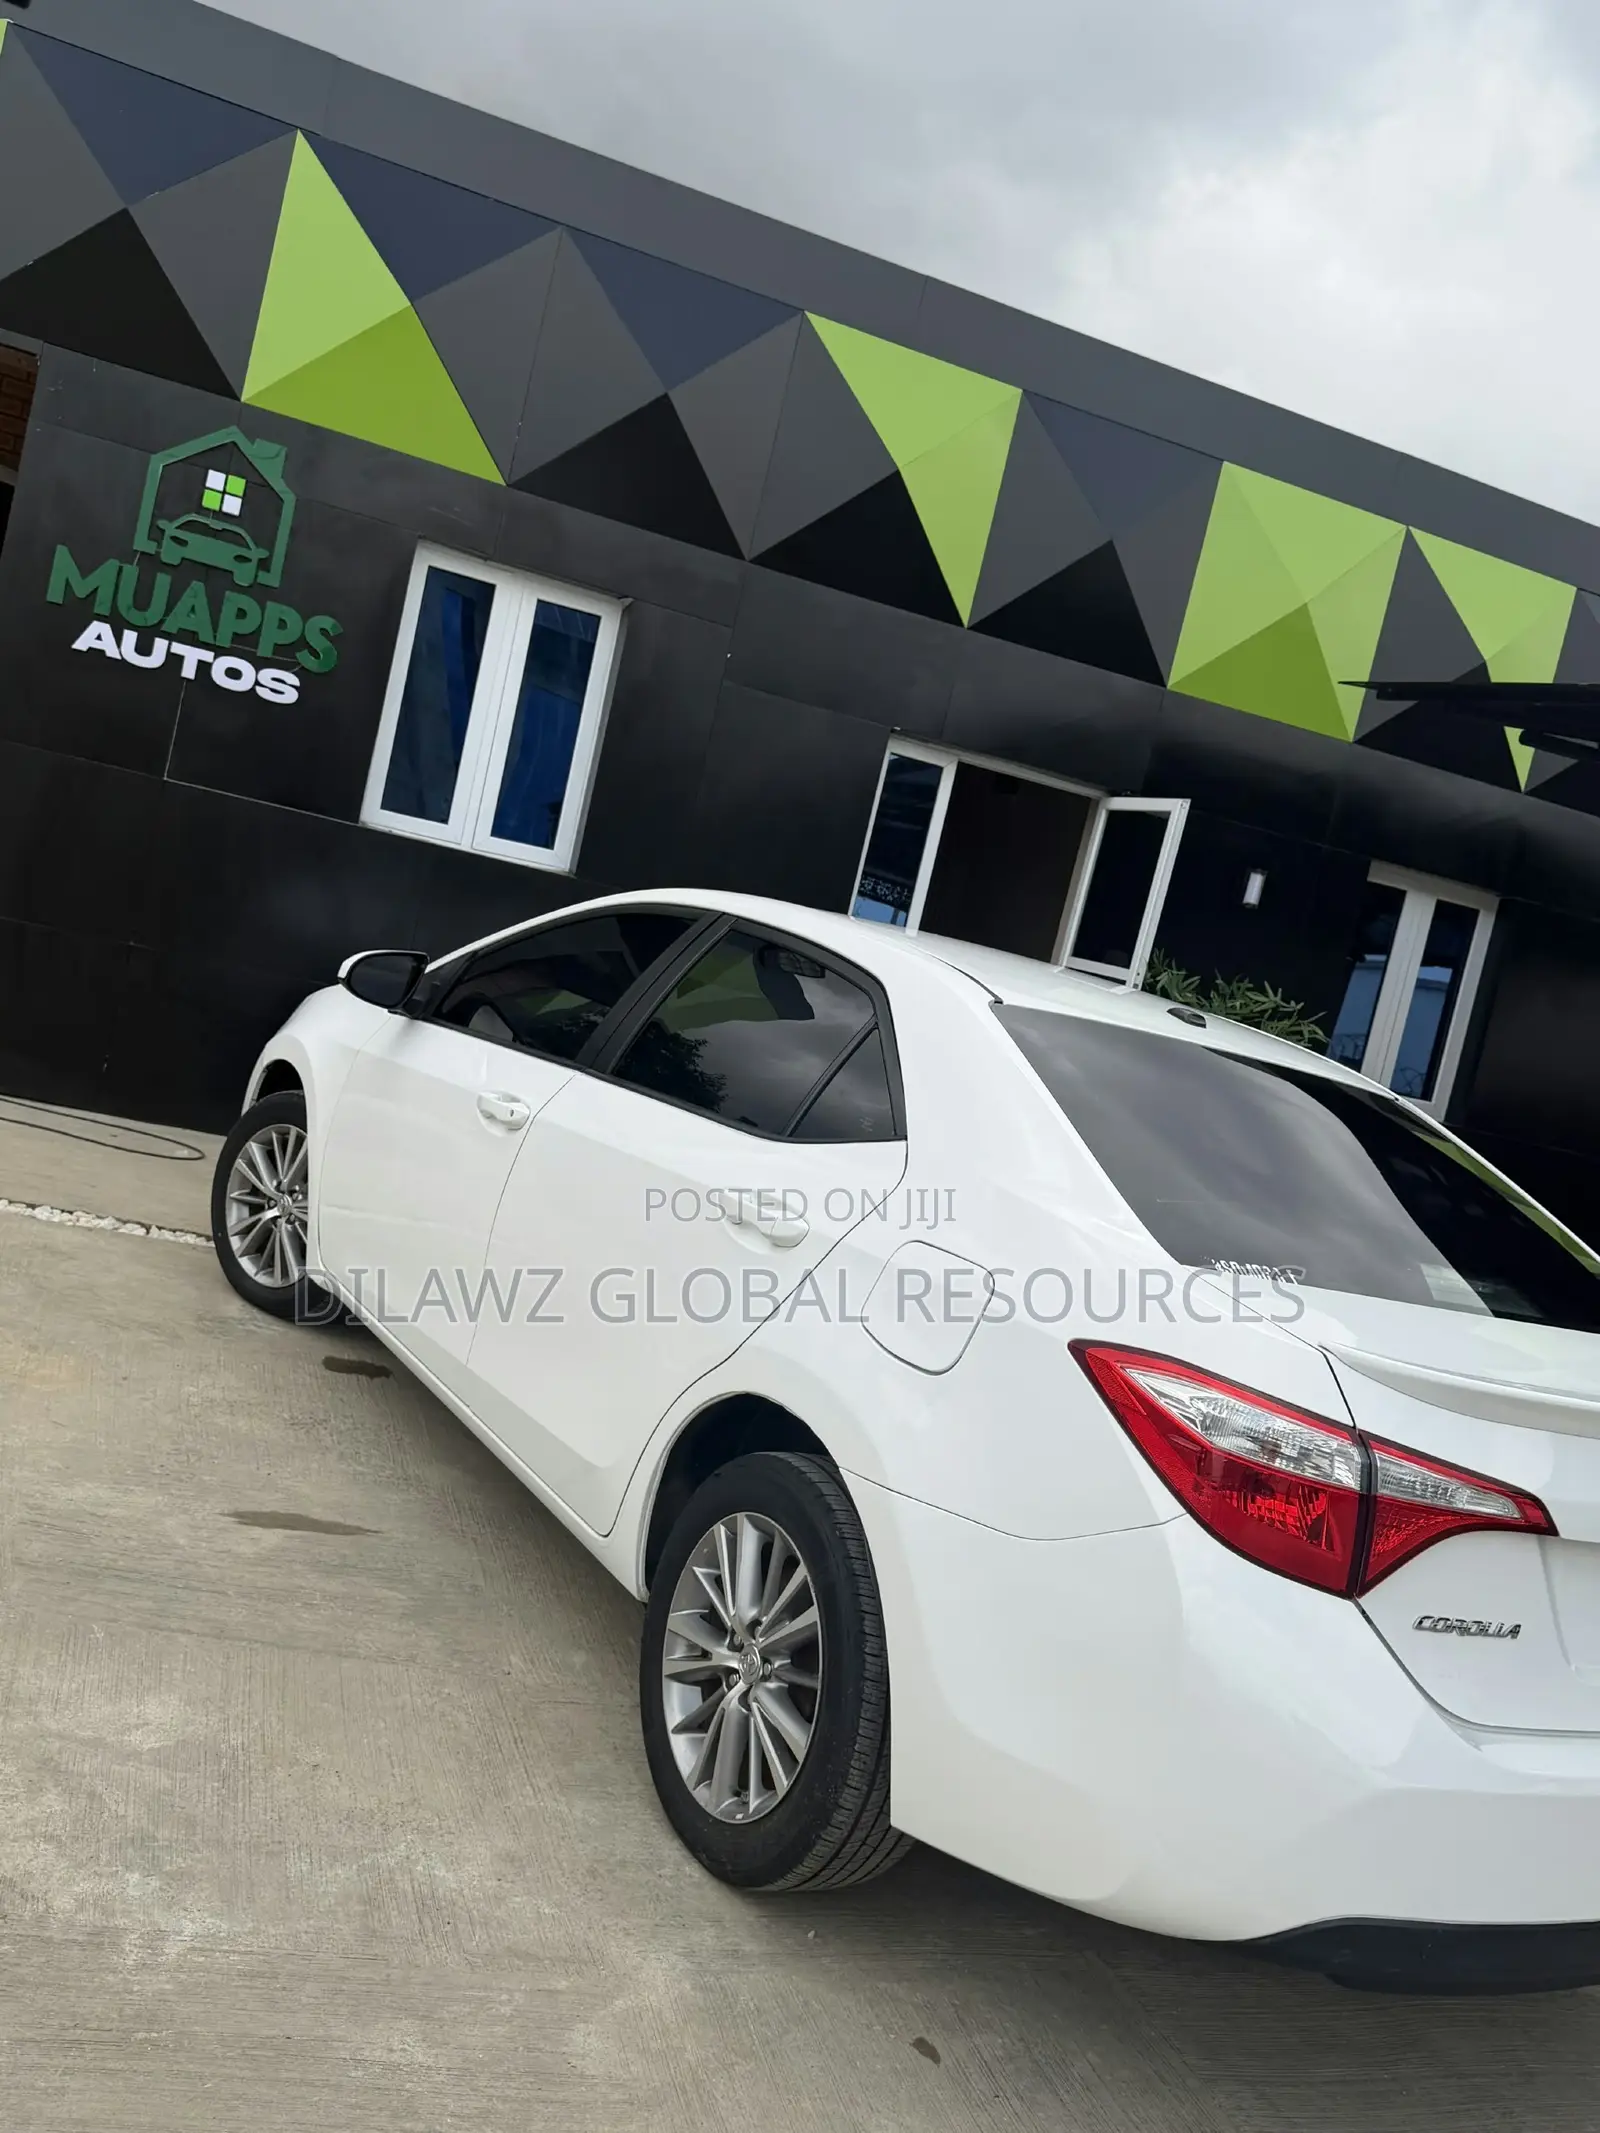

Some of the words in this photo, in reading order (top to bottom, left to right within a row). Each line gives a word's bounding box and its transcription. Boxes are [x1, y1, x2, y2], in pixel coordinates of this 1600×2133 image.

[46, 544, 343, 673] MUAPPS
[71, 620, 301, 704] AUTOS
[1412, 1615, 1521, 1640] COROLLA
